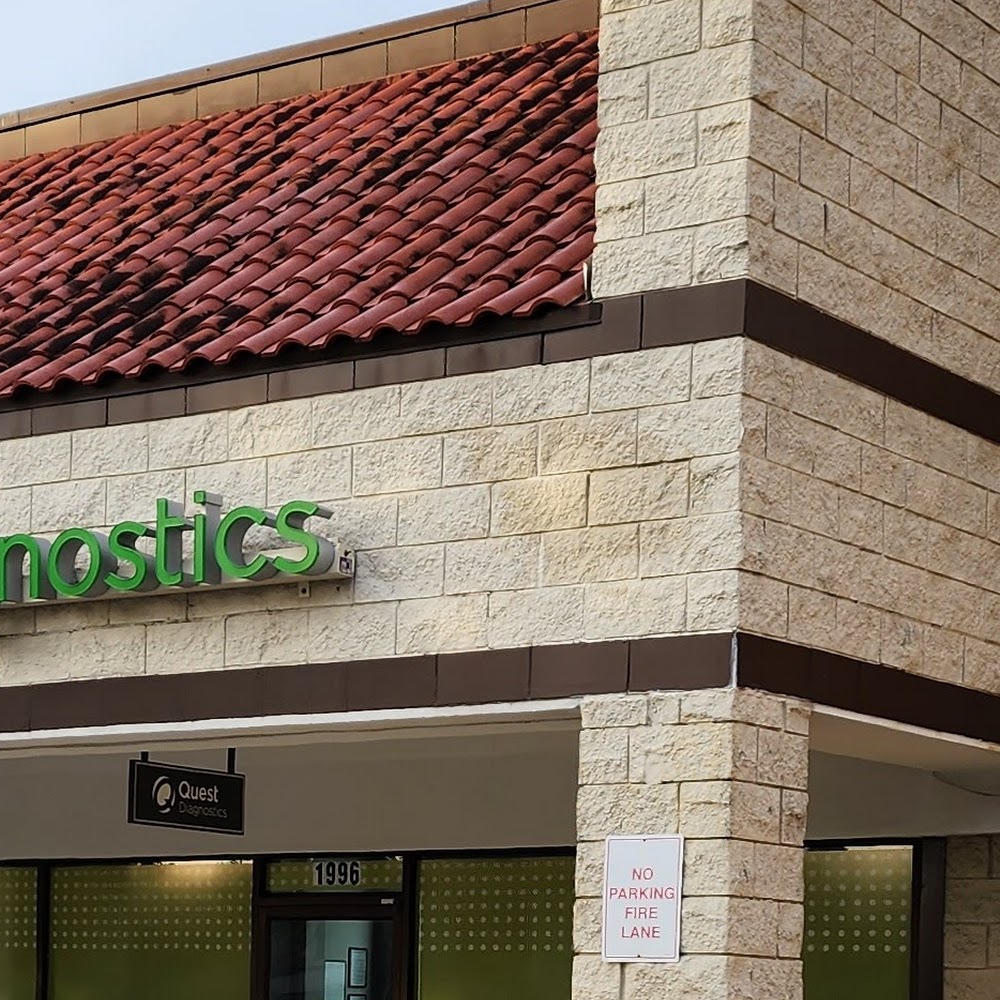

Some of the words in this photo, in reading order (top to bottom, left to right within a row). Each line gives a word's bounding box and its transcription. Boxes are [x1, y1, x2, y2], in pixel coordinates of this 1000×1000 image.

[178, 780, 219, 803] Quest
[179, 801, 228, 819] Diagnostics
[315, 861, 361, 886] 1996
[631, 867, 654, 881] NO
[608, 887, 676, 900] PARKING
[624, 906, 659, 919] FIRE
[621, 926, 660, 939] LANE
